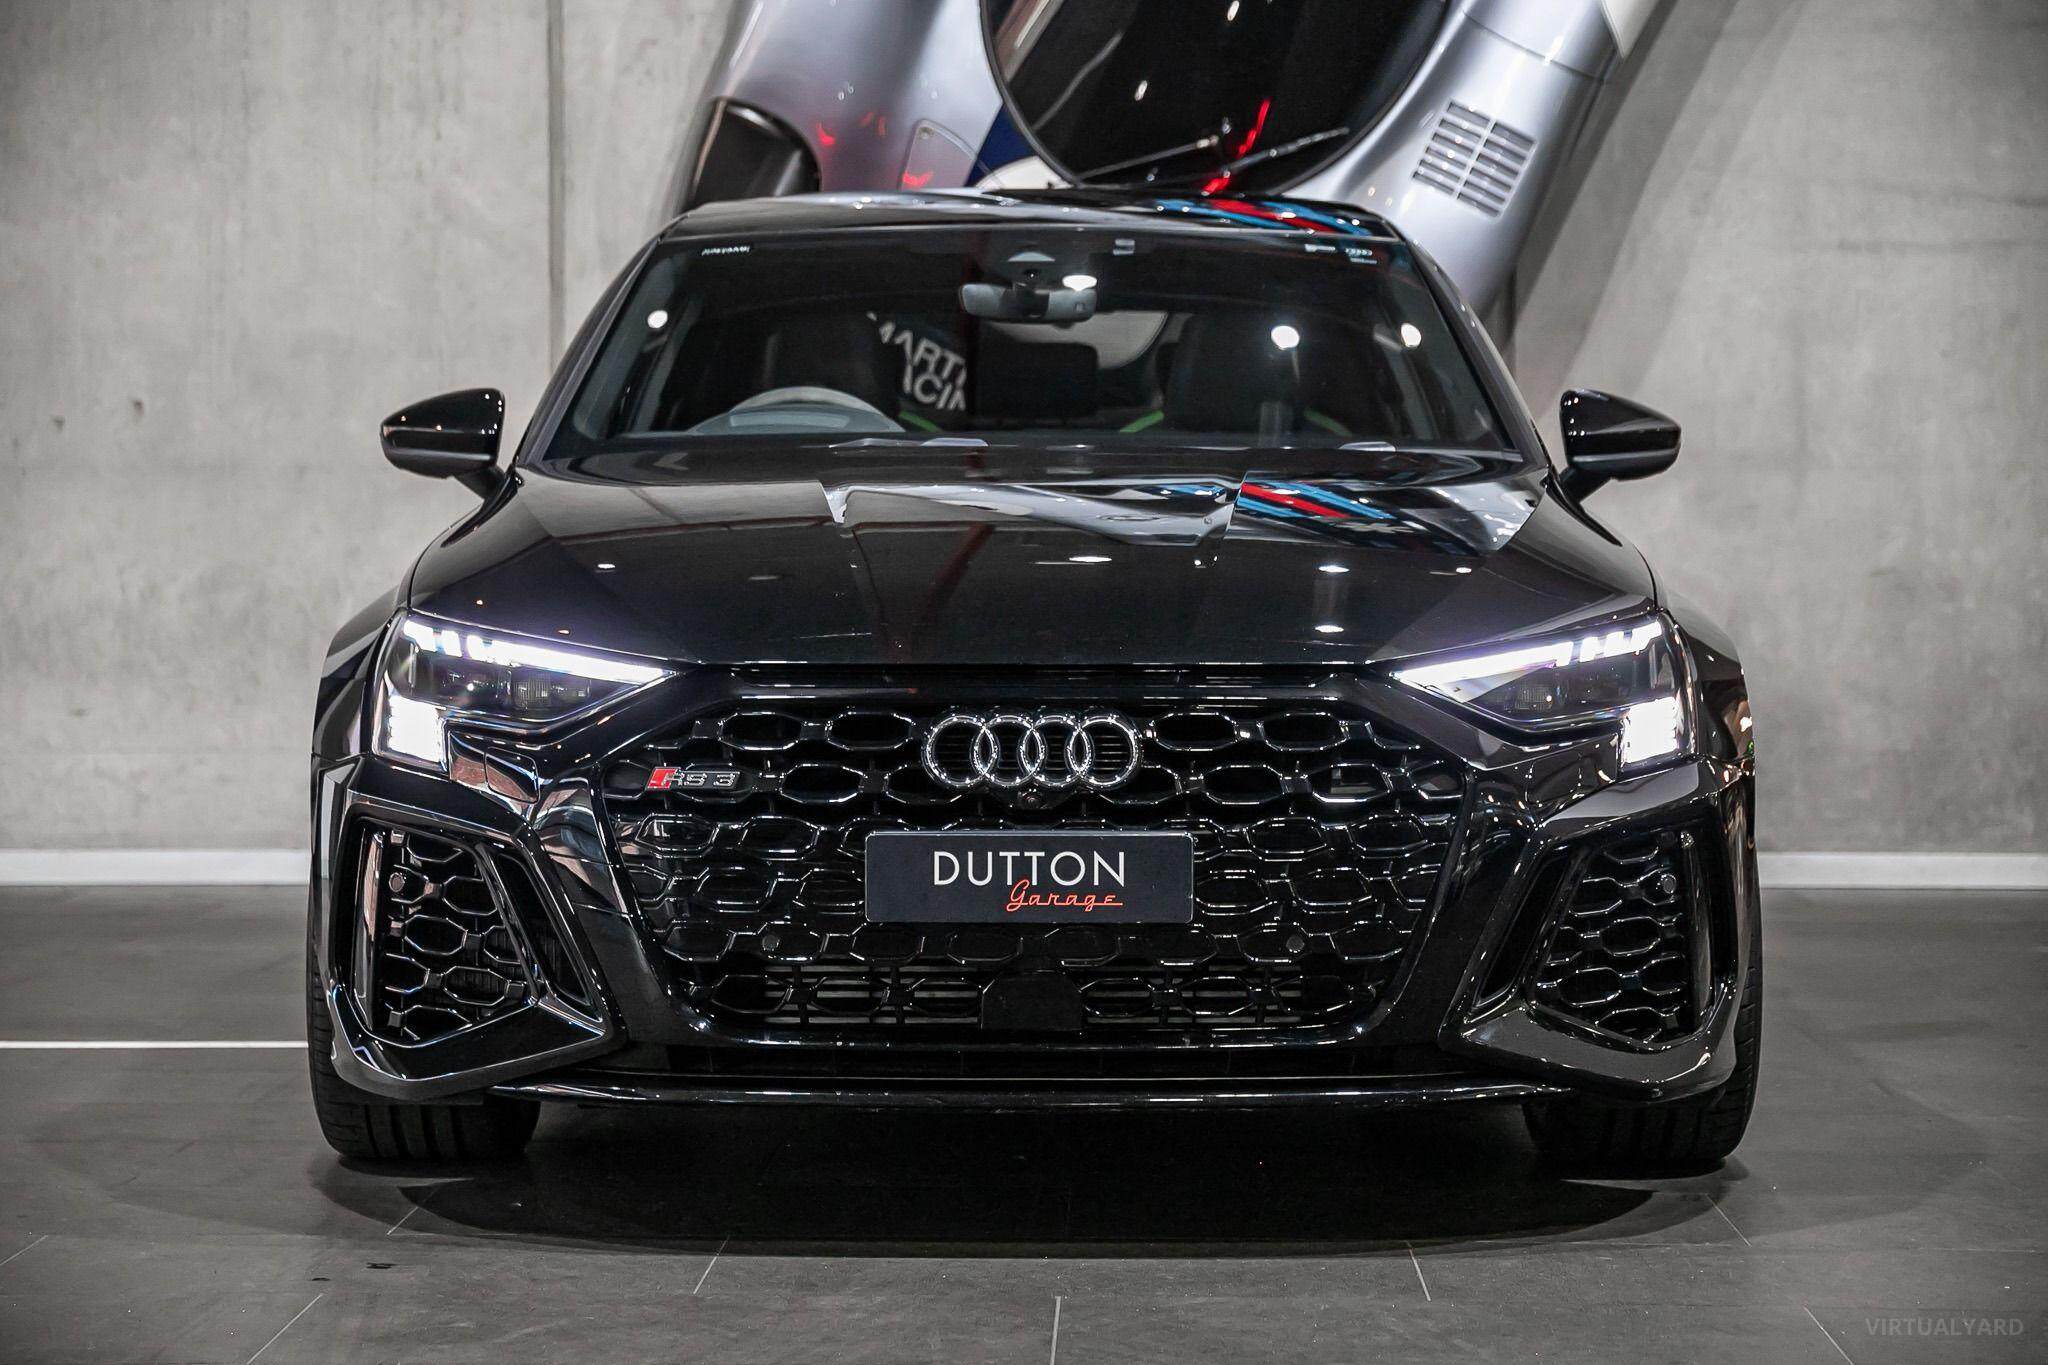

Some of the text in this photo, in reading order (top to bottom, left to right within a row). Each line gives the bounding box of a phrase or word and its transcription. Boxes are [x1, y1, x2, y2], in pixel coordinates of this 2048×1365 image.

[660, 770, 736, 787] RS 3
[933, 849, 1125, 887] DUTTON
[1006, 879, 1123, 912] Garage
